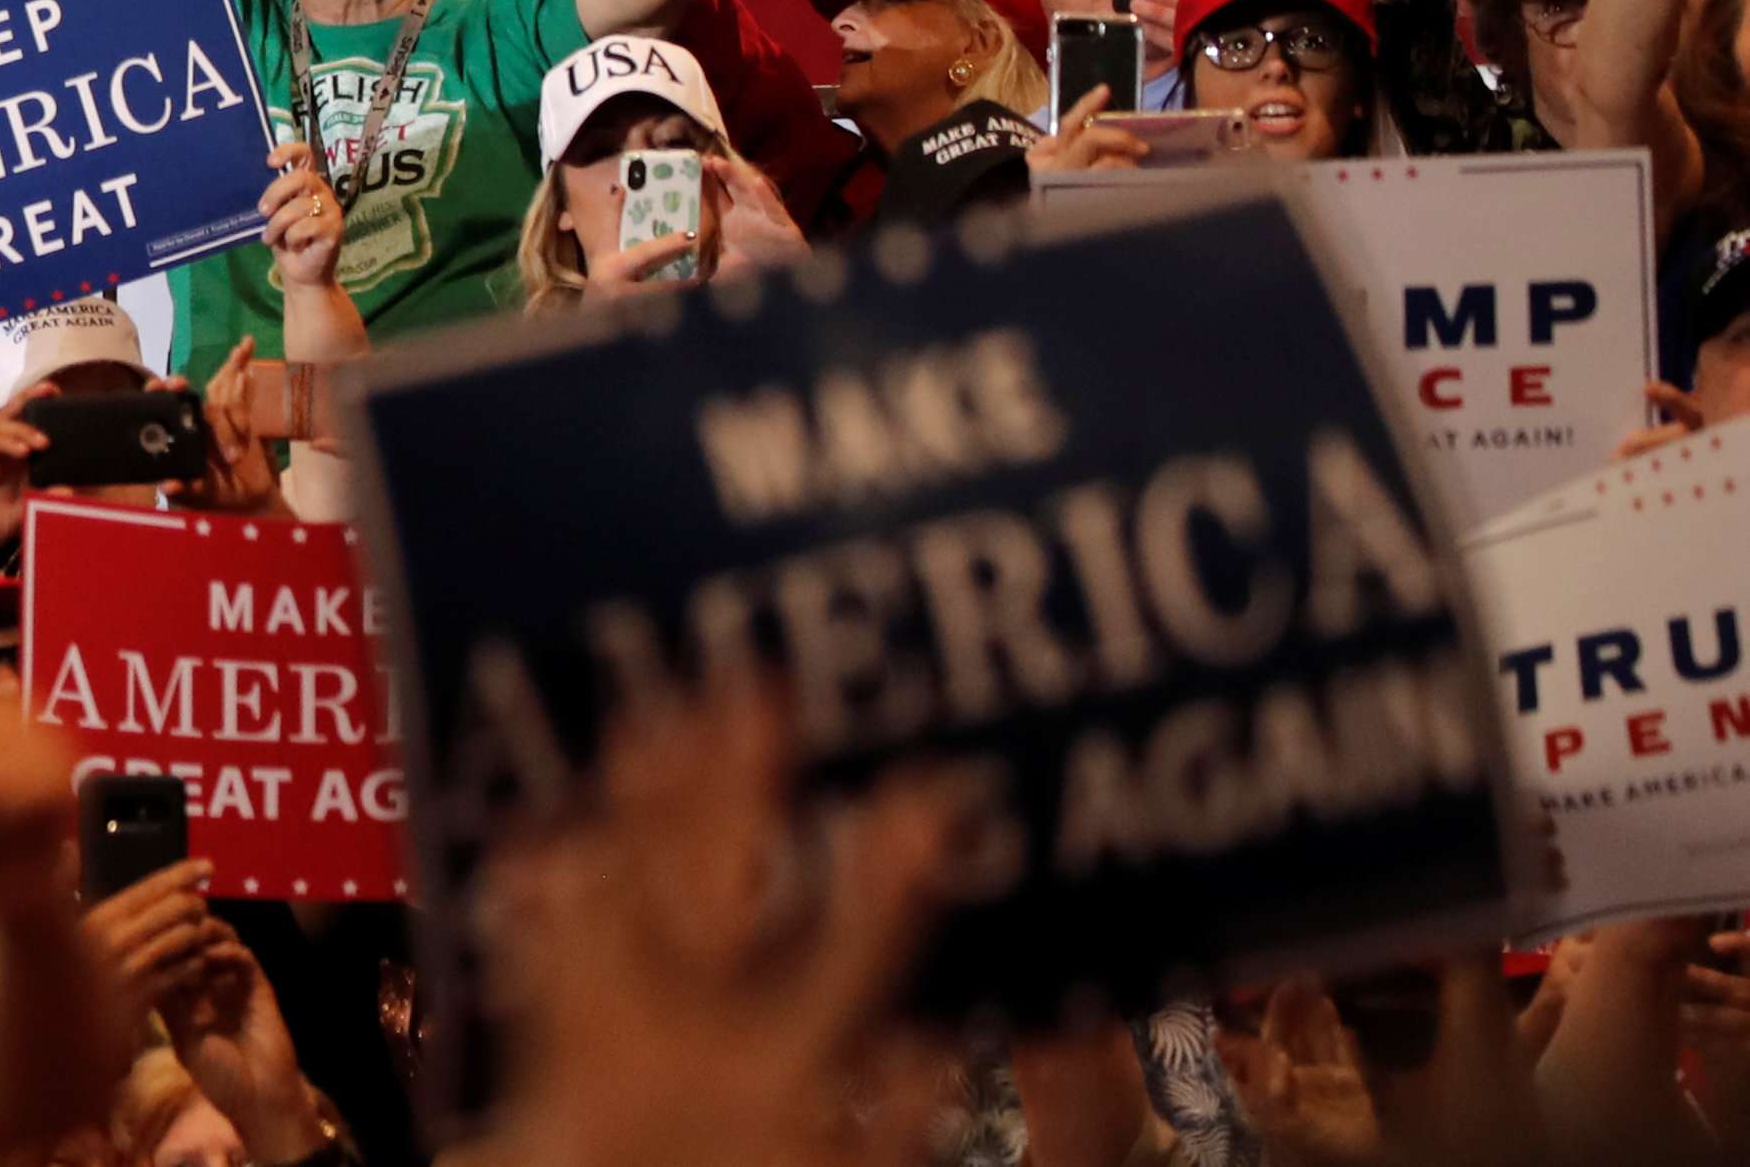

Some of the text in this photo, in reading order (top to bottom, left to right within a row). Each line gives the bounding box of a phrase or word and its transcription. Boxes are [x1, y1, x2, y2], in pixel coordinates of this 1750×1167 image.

[566, 41, 683, 97] USA
[13, 318, 60, 344] GREAT
[1404, 279, 1598, 352] MP
[1417, 365, 1553, 409] CE
[697, 328, 1064, 525] MAKE
[1472, 426, 1575, 449] AGAIN!
[209, 580, 387, 636] MAKE
[1499, 607, 1742, 714] TRU
